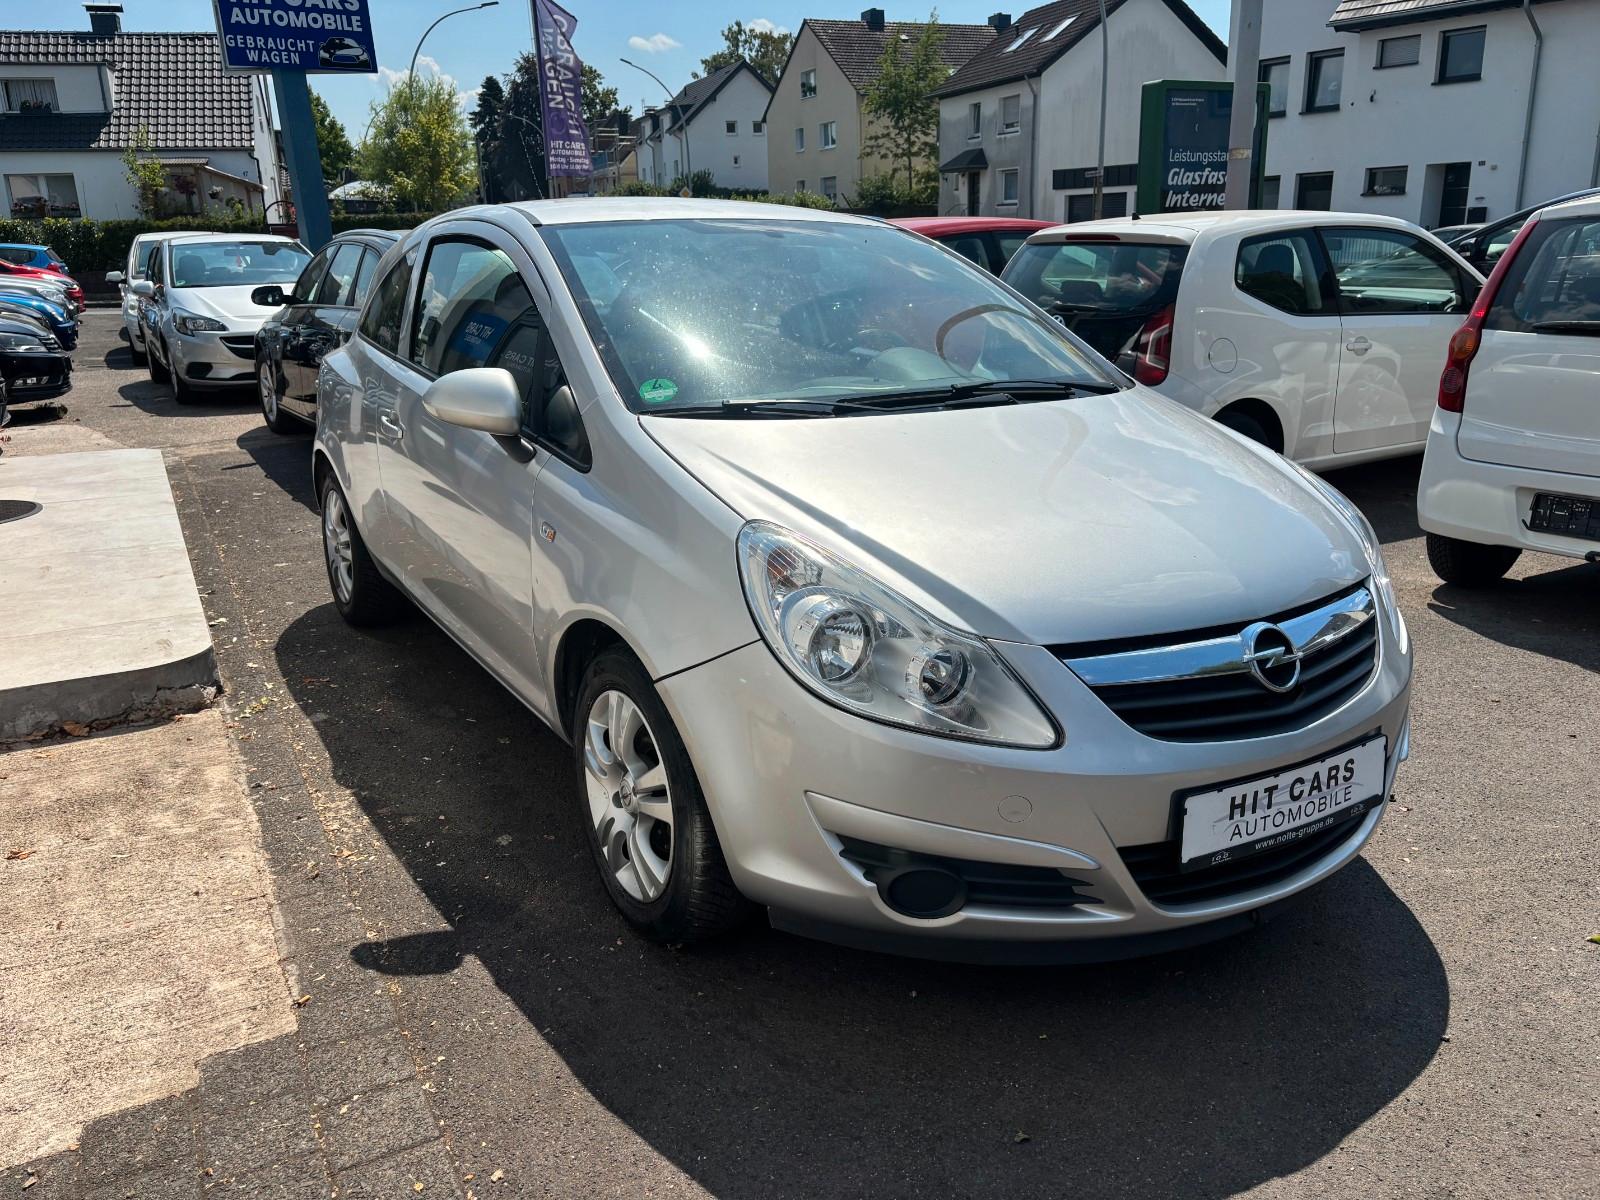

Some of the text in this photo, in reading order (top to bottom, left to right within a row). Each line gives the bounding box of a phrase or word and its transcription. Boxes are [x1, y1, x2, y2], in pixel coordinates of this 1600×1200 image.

[230, 7, 363, 32] AUTOMOBILE
[225, 34, 315, 53] GEBRAUCHT
[246, 50, 300, 65] WAGEN
[550, 140, 564, 149] HIT
[1167, 167, 1227, 186] Glasfas
[1229, 758, 1355, 821] HIT CARS
[1230, 785, 1352, 842] AUTOMOBILE
[1255, 817, 1335, 850] www.nolte-gruppe.de
